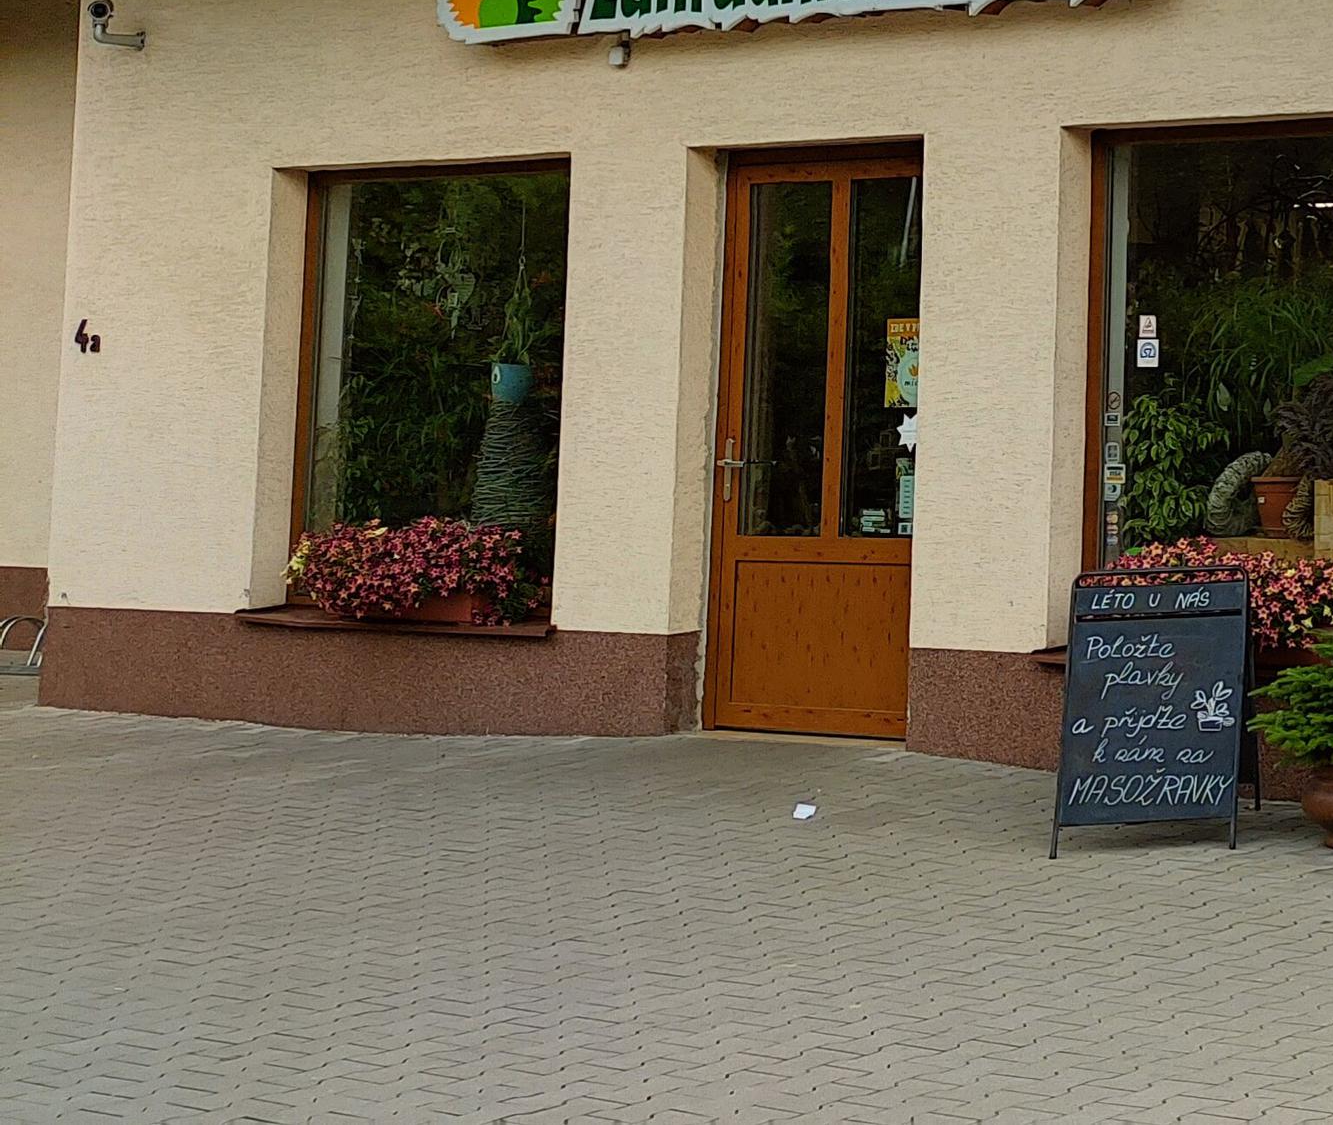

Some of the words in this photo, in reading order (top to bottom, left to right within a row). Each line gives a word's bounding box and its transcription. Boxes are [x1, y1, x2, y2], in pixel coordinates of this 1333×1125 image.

[74, 319, 101, 354] 4a
[1091, 589, 1135, 610] LÉTO
[1149, 593, 1161, 608] U
[1175, 587, 1210, 610] NÁS
[1086, 634, 1176, 660] Položte
[1101, 662, 1184, 700] plavky
[1071, 717, 1094, 734] a
[1092, 738, 1110, 763] k
[1114, 735, 1165, 763] nám
[1176, 748, 1215, 763] na
[1068, 768, 1234, 806] MASOŽRAVKY
